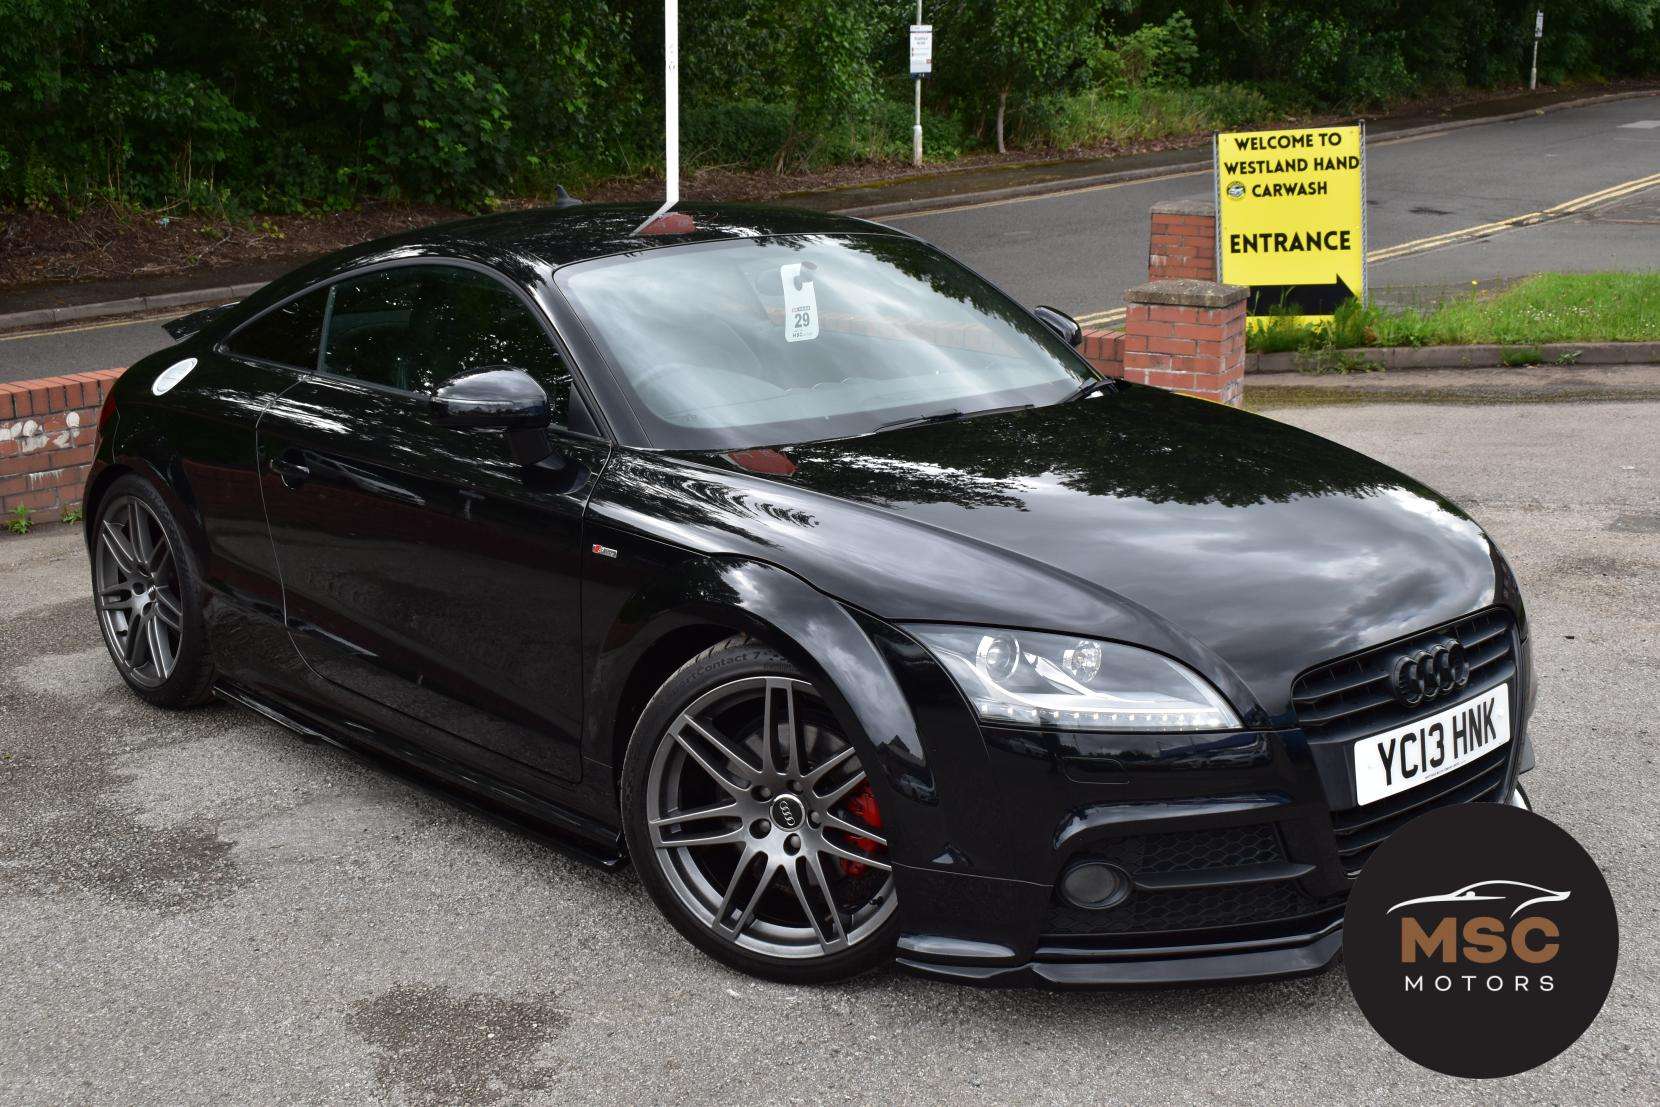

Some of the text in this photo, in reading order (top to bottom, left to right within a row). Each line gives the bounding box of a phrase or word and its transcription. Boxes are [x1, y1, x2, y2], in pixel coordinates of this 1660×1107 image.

[1234, 133, 1342, 151] WELCOME TO
[1224, 156, 1360, 175] WESTLAND HAND
[1252, 182, 1328, 198] CARWASH
[1230, 231, 1351, 254] ENTRANCE
[794, 312, 810, 329] 29
[1377, 697, 1497, 786] YC13 HNK
